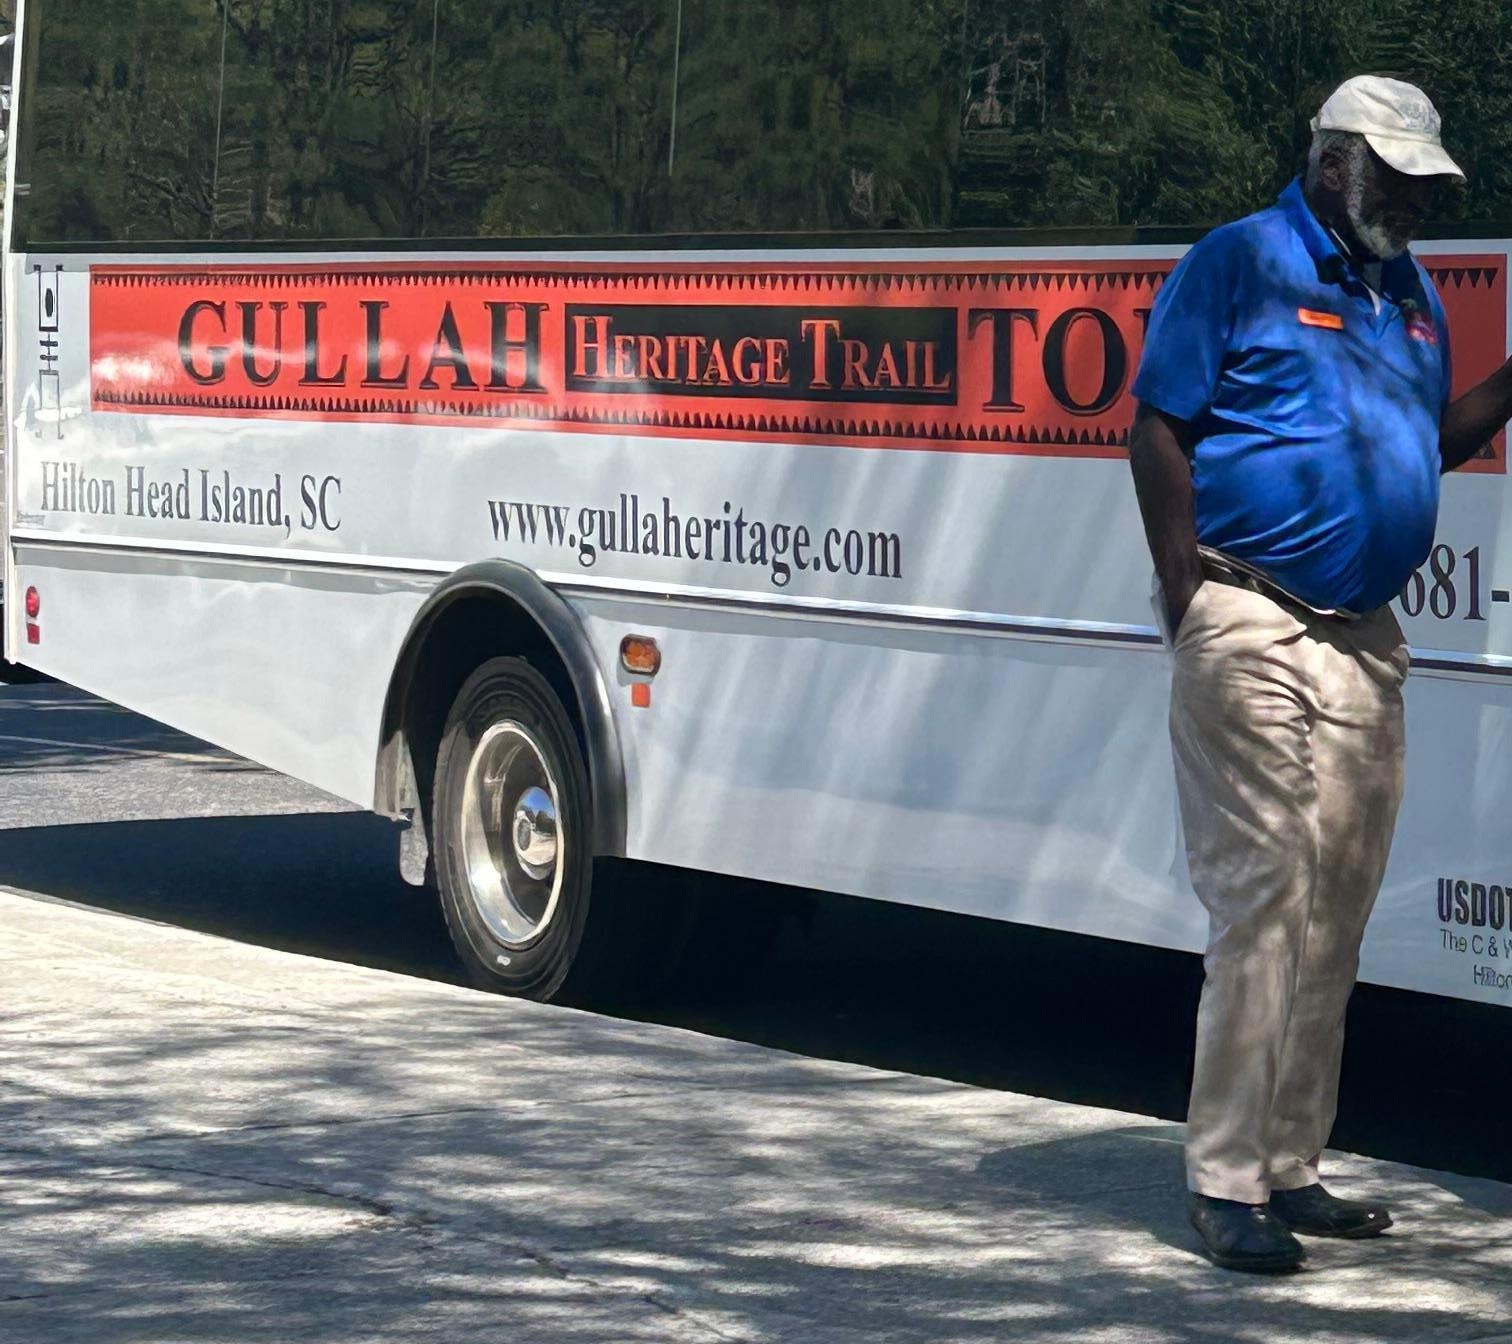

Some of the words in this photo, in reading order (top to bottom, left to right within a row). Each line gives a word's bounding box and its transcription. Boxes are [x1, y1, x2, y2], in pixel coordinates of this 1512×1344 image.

[177, 300, 548, 394] GULLAH
[572, 315, 790, 387] HERITAGE
[801, 319, 951, 392] TRAIL
[968, 307, 1152, 416] TO
[40, 460, 117, 515] Hilton
[125, 464, 191, 521] Head
[199, 468, 290, 538] Island,
[300, 475, 342, 531] SC
[488, 493, 902, 587] www.gullaheritage.com
[1440, 929, 1467, 953] The
